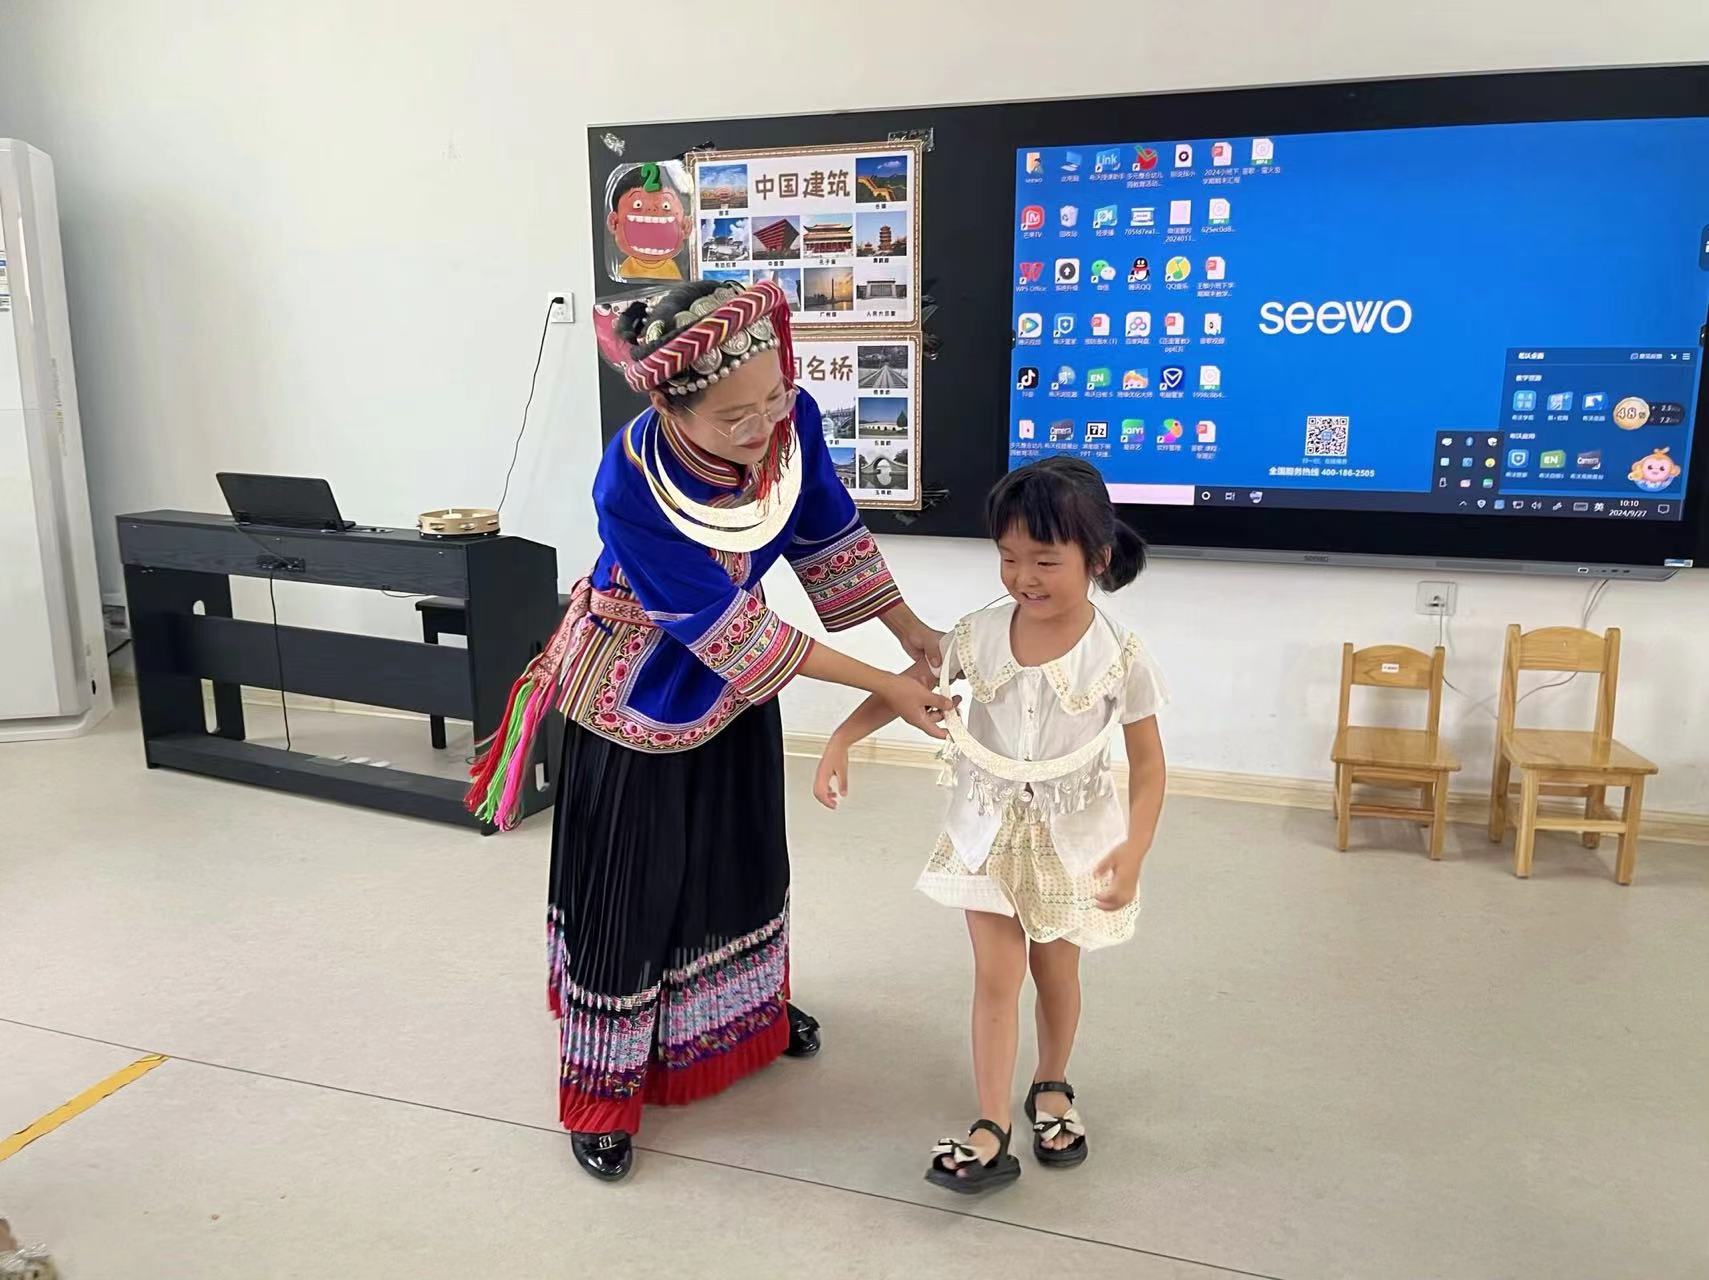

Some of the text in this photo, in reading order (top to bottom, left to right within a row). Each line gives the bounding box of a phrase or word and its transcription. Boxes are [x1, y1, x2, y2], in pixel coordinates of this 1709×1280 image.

[641, 163, 661, 192] 2
[755, 169, 851, 200] 中国建筑
[1258, 300, 1413, 334] seewo
[1594, 502, 1605, 512] 英
[1609, 509, 1648, 518] 2024/9/27
